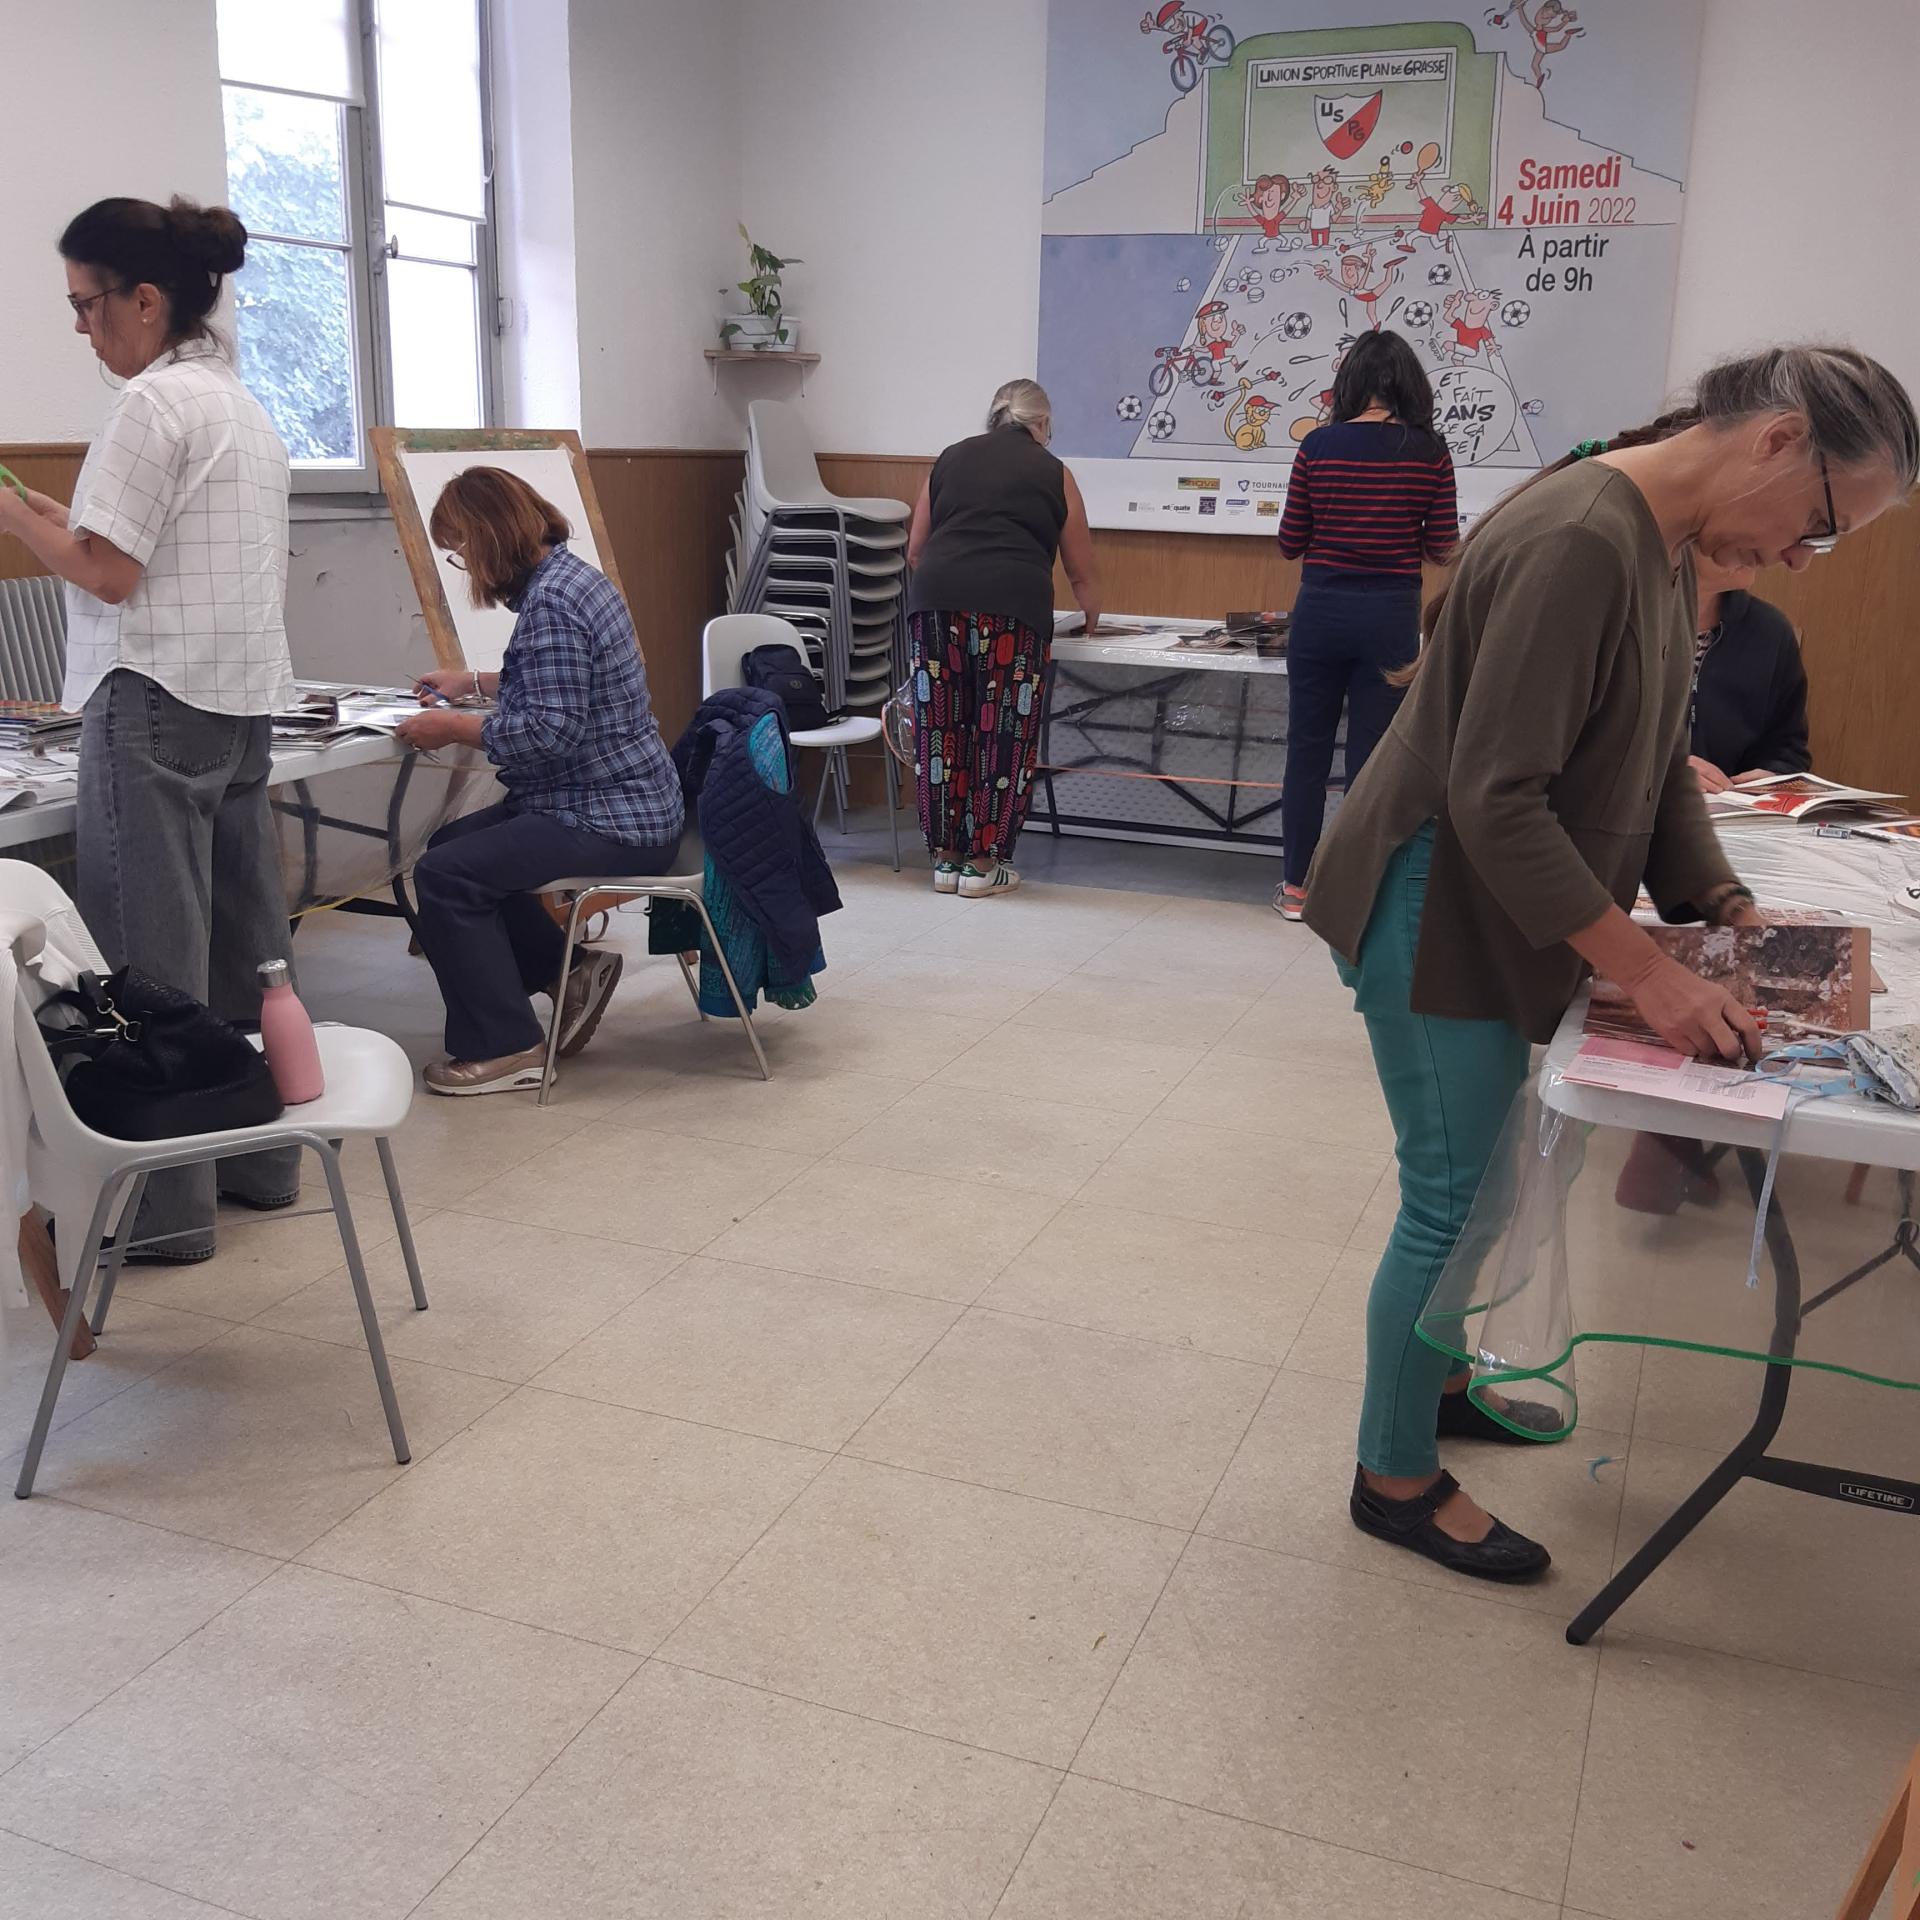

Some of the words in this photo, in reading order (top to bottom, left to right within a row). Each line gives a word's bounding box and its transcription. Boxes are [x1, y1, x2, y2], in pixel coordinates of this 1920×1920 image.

[1259, 67, 1300, 83] UNION
[1302, 64, 1359, 82] SPORTIVE
[1360, 62, 1391, 80] PLAN
[1403, 59, 1446, 76] GRASSE
[1518, 156, 1622, 191] Samedi
[1497, 195, 1515, 226] 4
[1522, 193, 1580, 226] Juin
[1587, 197, 1637, 224] 2022
[1517, 227, 1536, 259] À
[1542, 232, 1610, 264] partir
[1525, 267, 1556, 292] de
[1563, 266, 1594, 292] 9h
[1439, 371, 1469, 388] ET
[1453, 386, 1494, 403] FAIT
[1443, 404, 1496, 423] ANS
[1252, 481, 1289, 489] TOURNAI
[1847, 1485, 1905, 1506] LIFETIME
